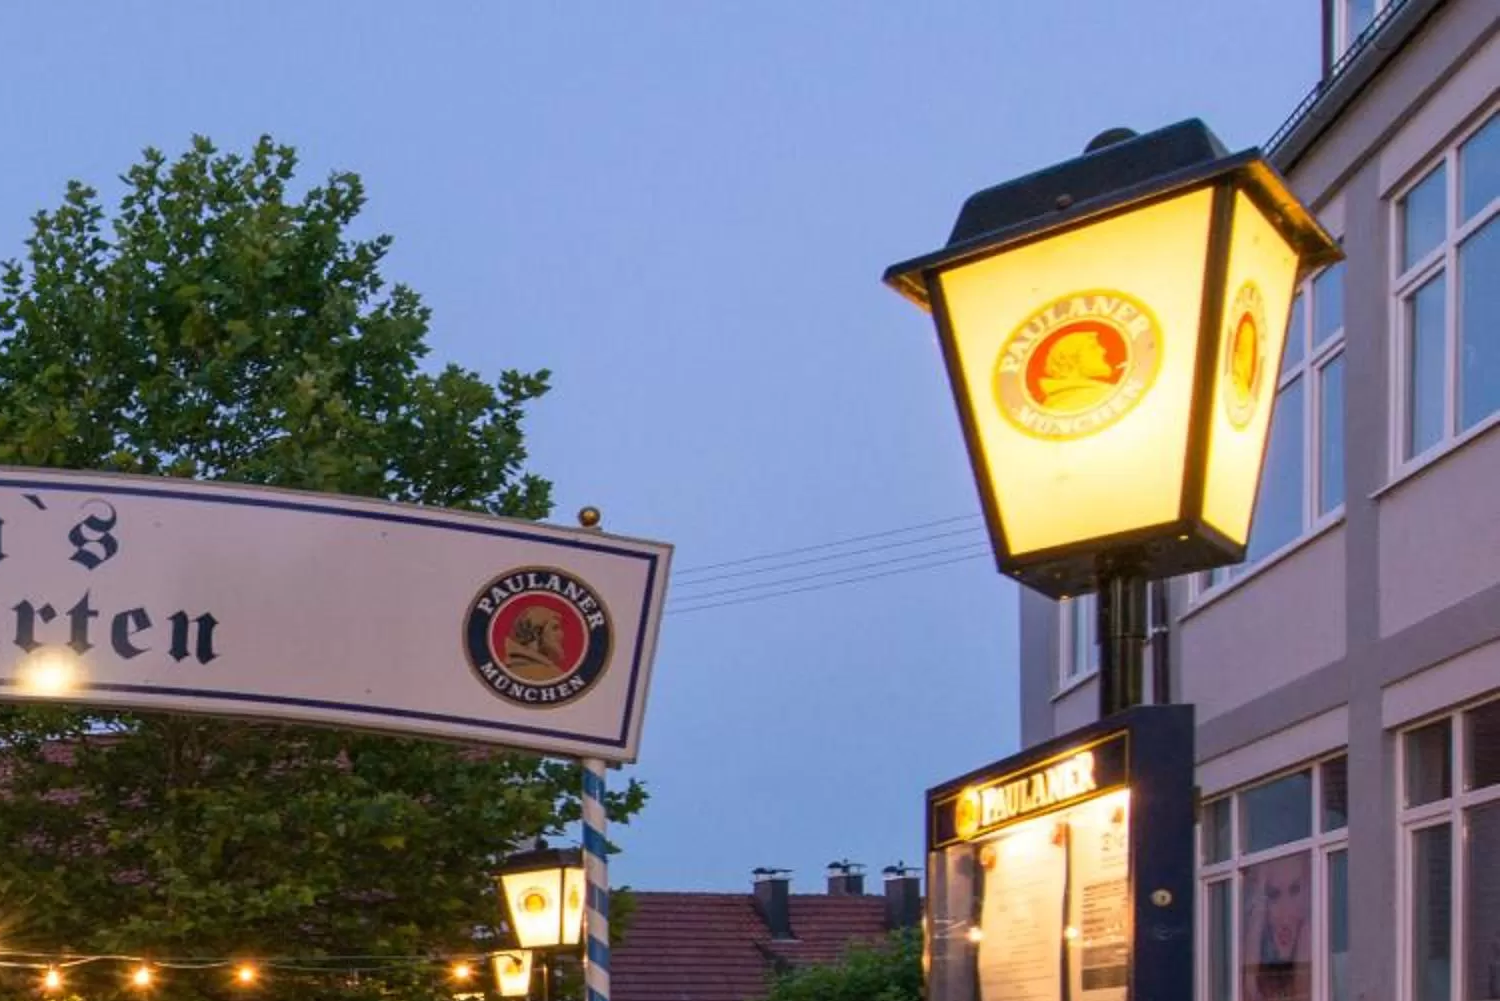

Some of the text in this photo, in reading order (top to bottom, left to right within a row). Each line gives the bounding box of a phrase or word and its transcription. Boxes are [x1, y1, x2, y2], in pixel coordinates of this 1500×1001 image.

[1001, 295, 1153, 376] PAULANER
[477, 573, 605, 630] PAULANER
[980, 750, 1098, 826] PAULANER
